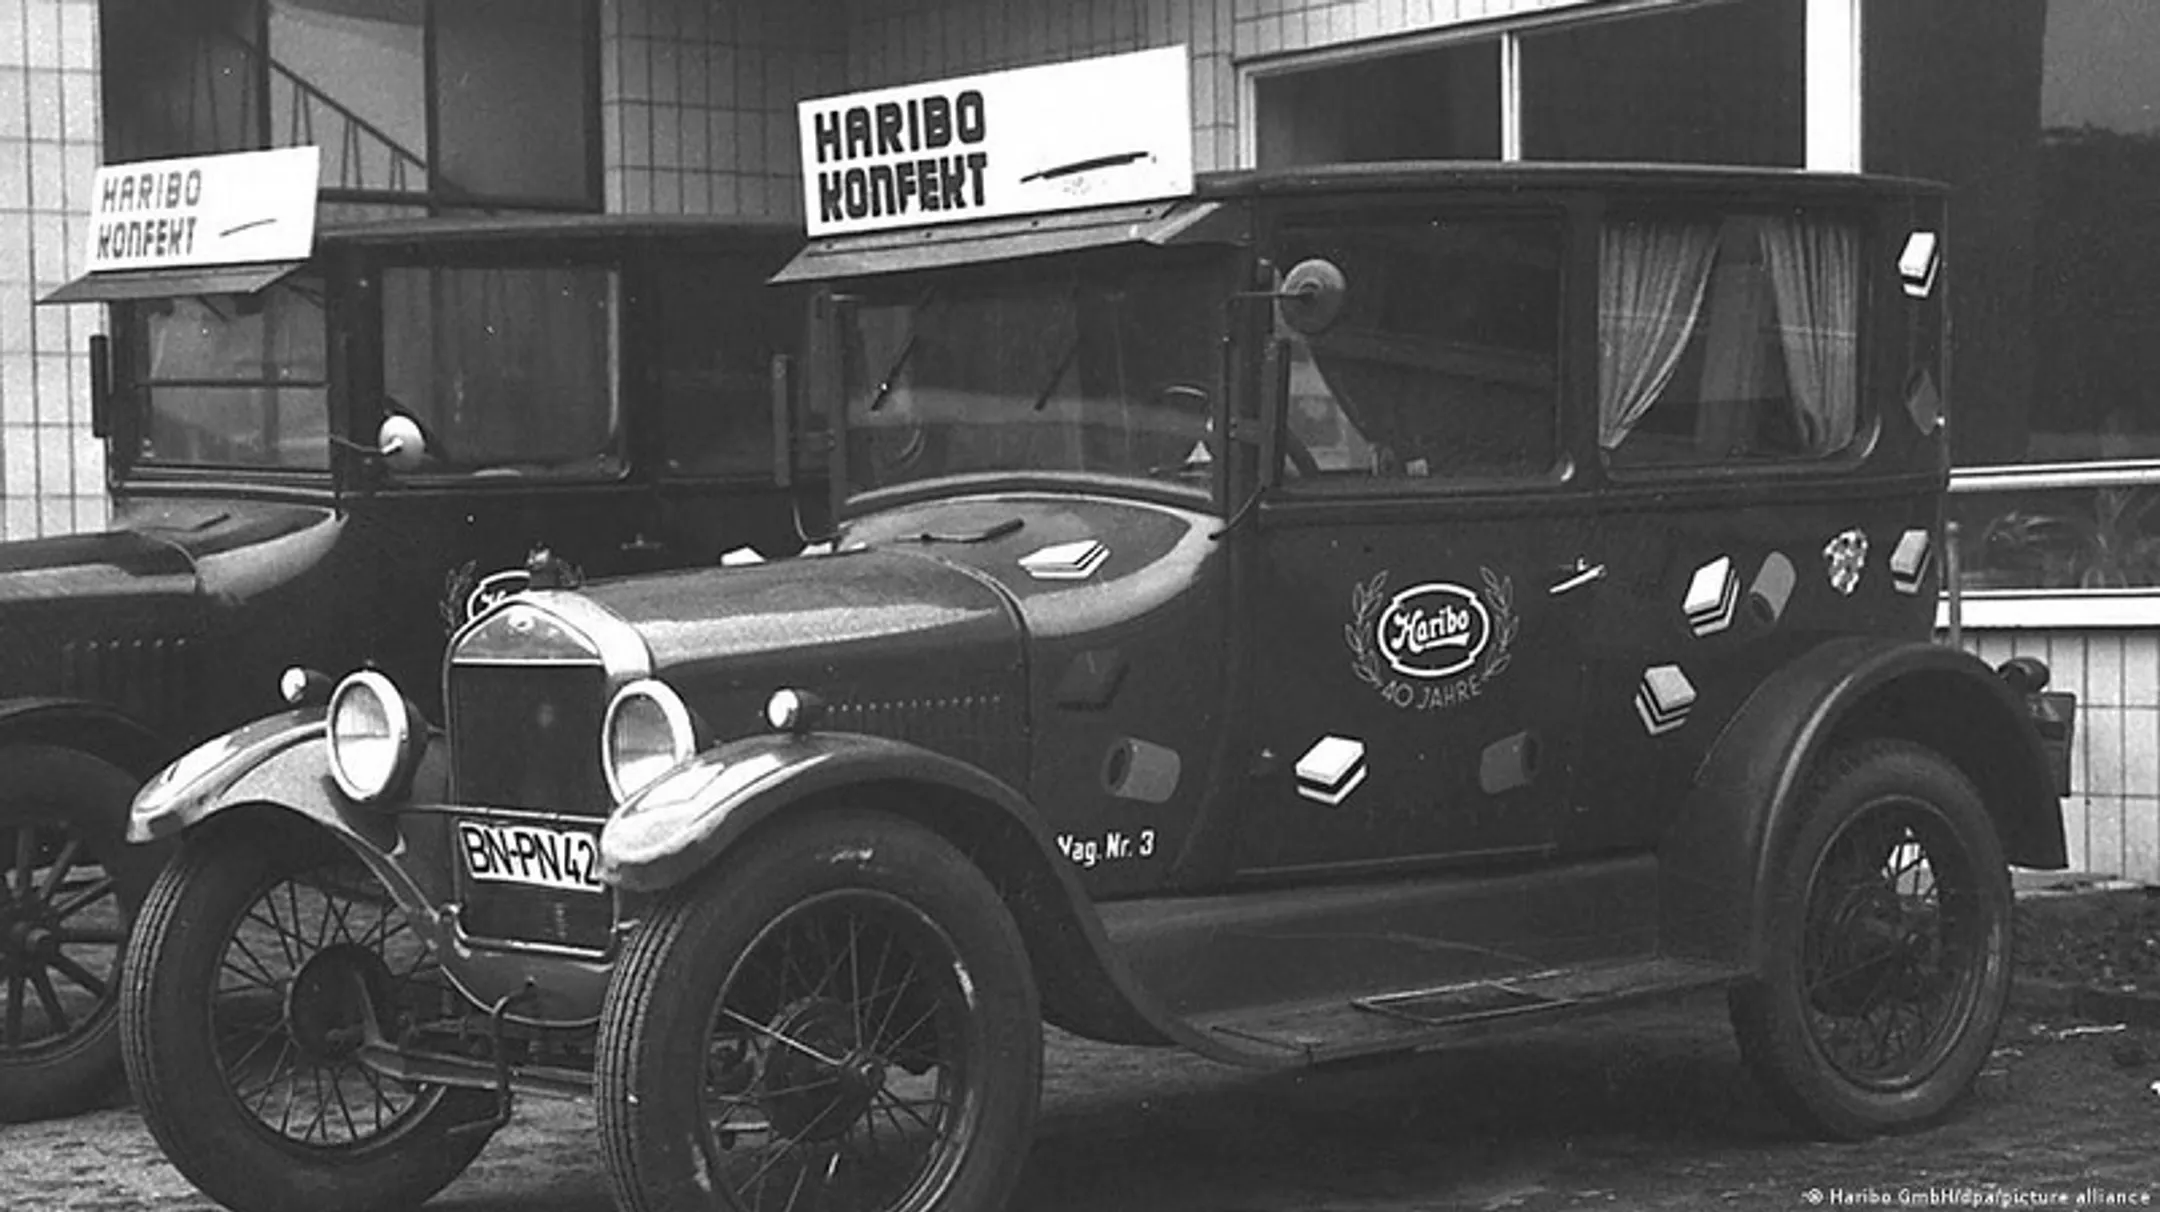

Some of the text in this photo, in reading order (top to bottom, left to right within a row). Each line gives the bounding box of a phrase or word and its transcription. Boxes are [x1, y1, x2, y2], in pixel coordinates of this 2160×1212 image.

[813, 90, 986, 163] HARIBO
[101, 169, 202, 213] HARIBO
[818, 151, 987, 223] KONFEKT
[97, 216, 198, 260] KONFEKT
[1391, 605, 1470, 653] Haribo
[1381, 674, 1483, 709] 40 JAHRE
[1106, 832, 1133, 859] Nr.
[1139, 830, 1155, 855] 3
